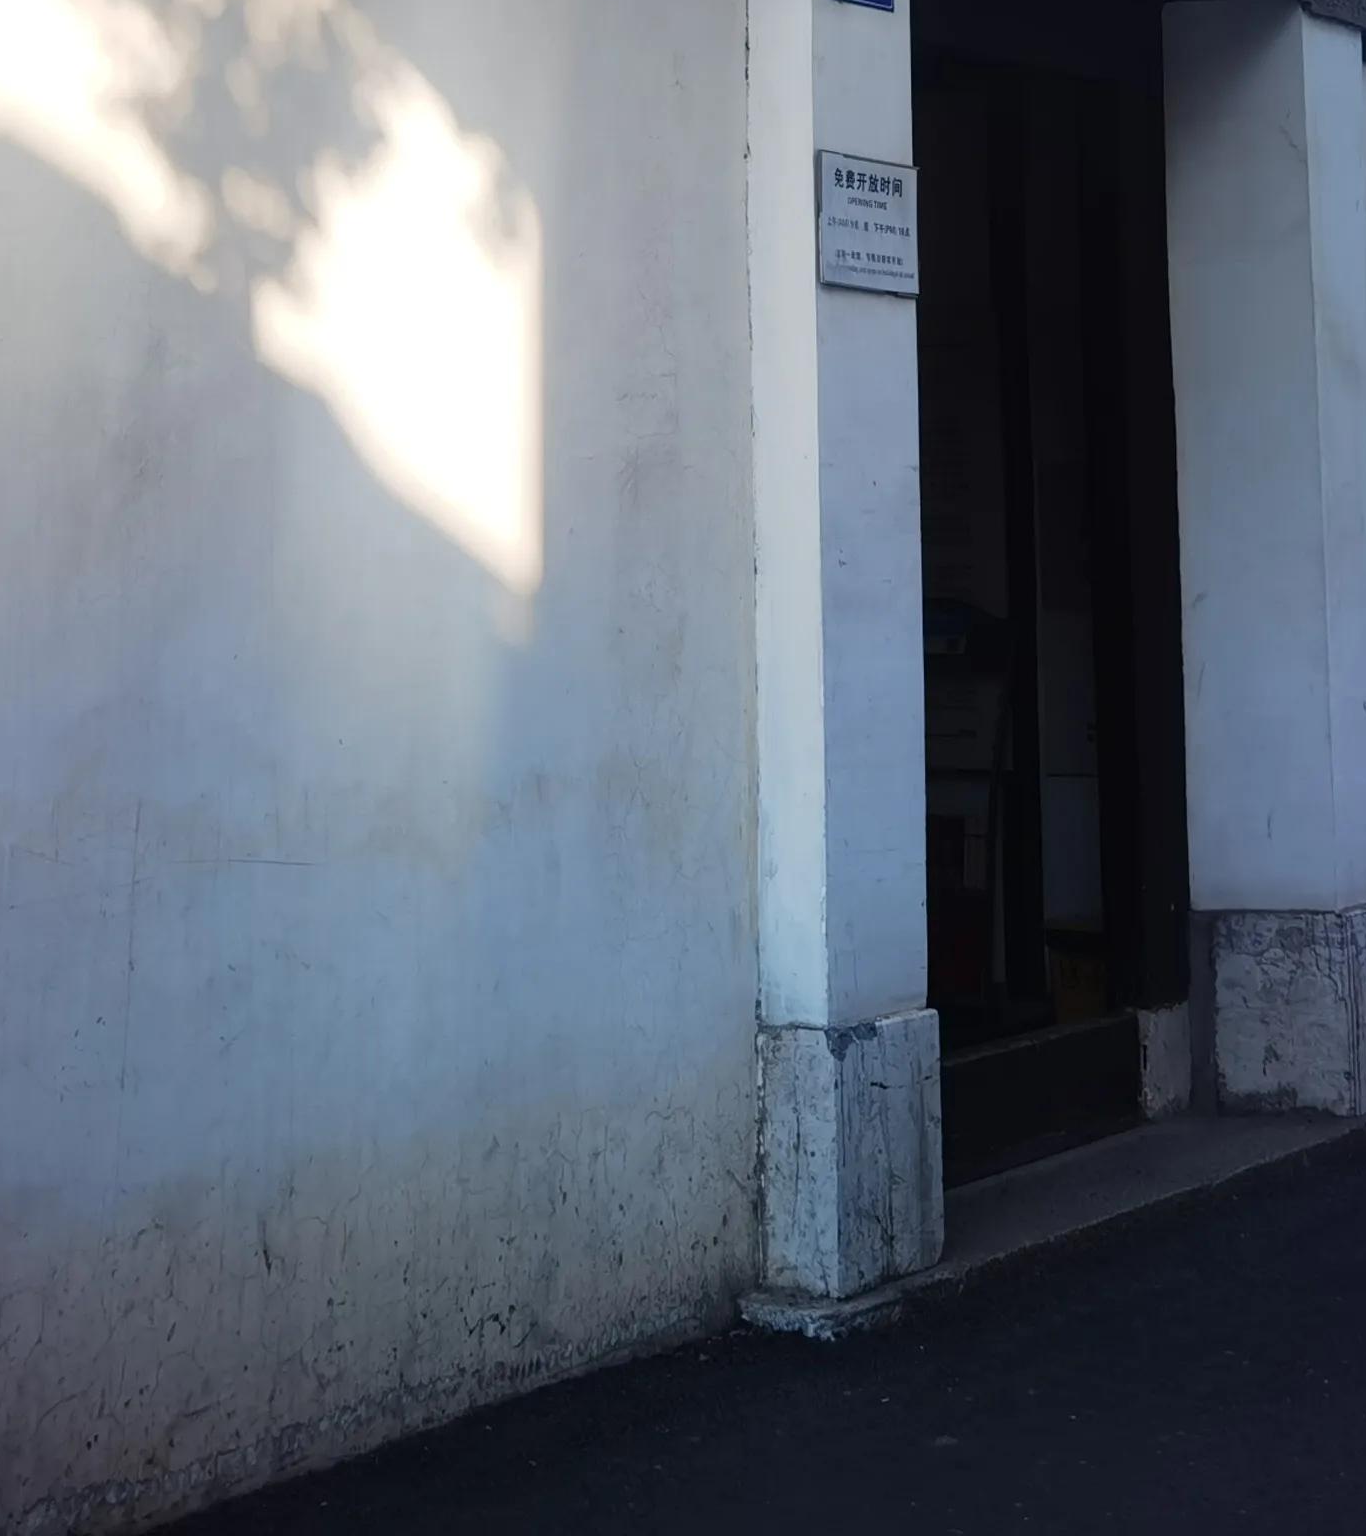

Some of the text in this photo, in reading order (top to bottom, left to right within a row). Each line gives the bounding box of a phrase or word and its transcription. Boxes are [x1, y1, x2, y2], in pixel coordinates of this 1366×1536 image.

[834, 167, 903, 198] 免费开放时间
